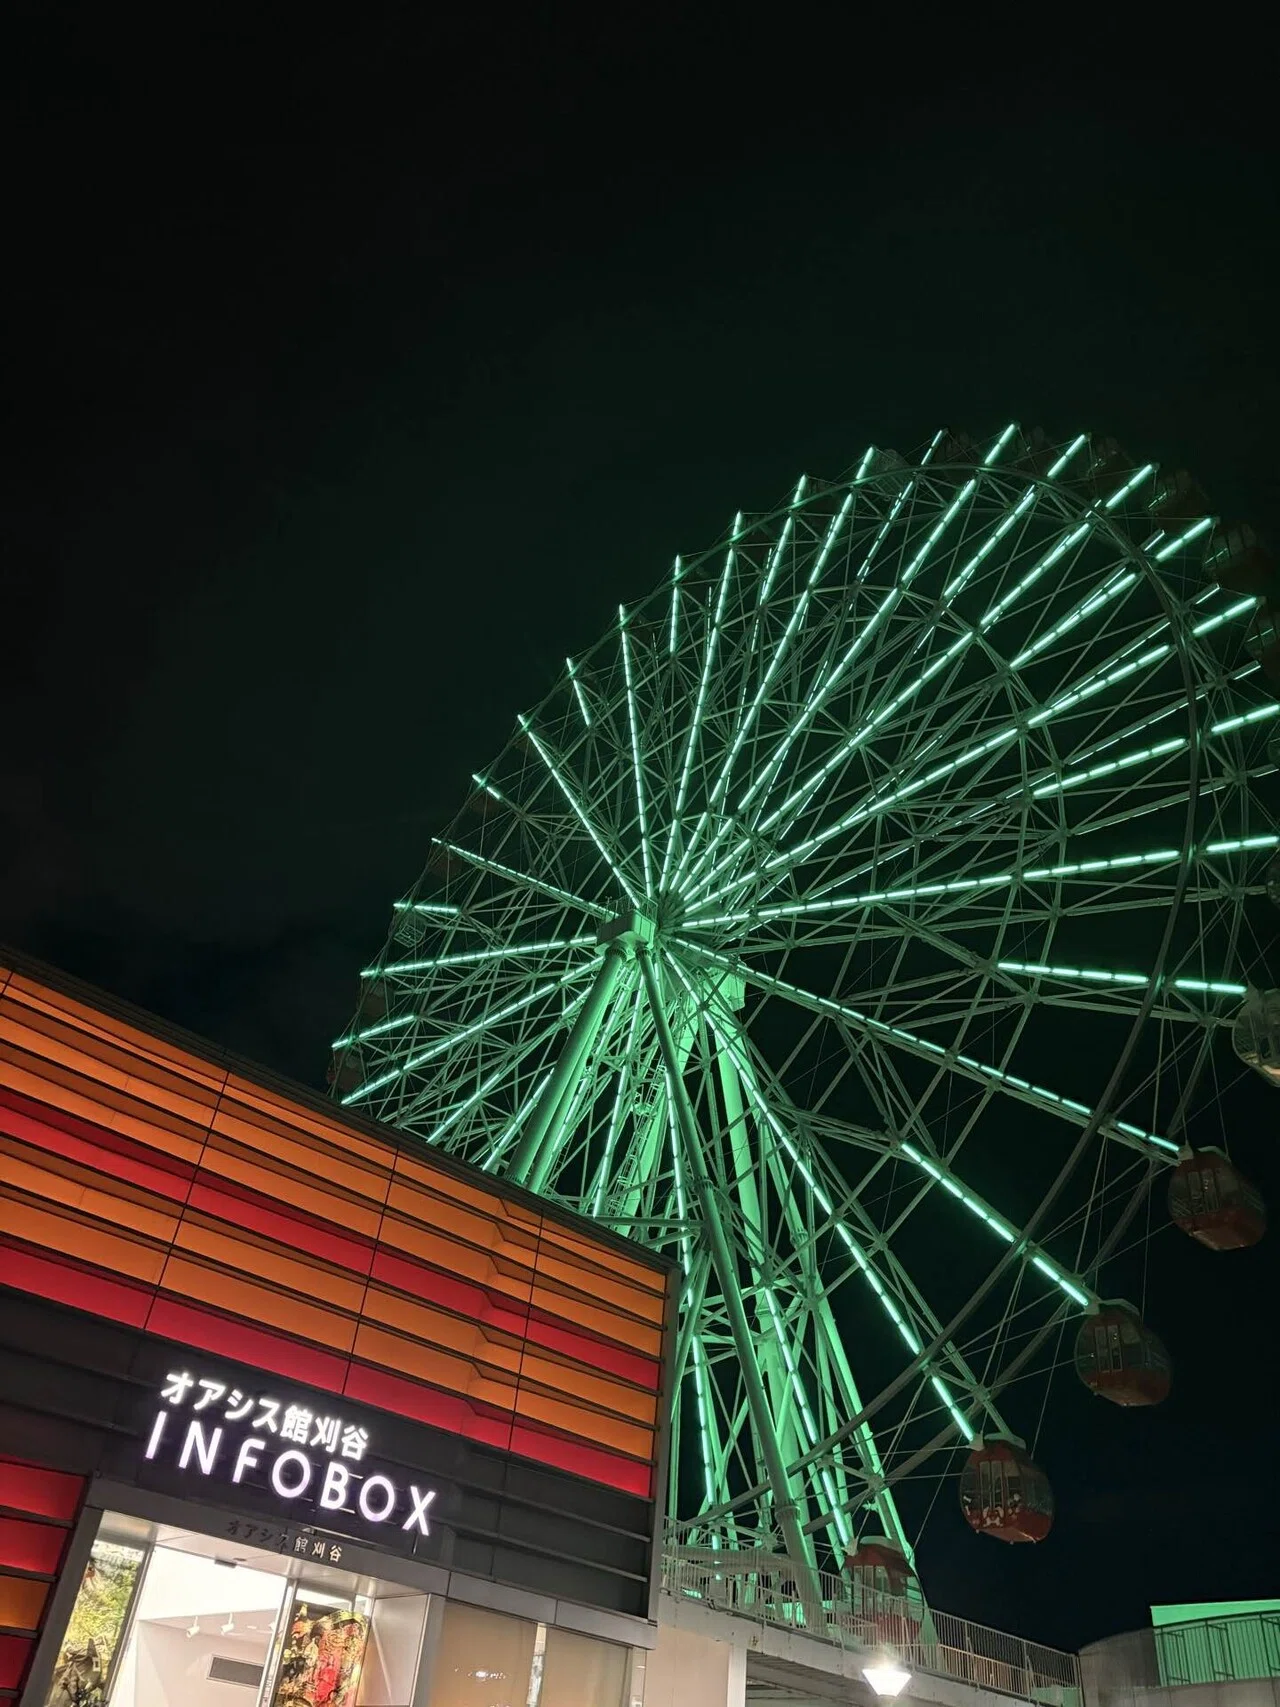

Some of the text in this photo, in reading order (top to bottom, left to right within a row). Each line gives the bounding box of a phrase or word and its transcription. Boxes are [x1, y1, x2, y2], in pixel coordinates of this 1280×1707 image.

[161, 1371, 370, 1460] オアシス館刈谷
[145, 1411, 436, 1535] INFOBOX
[227, 1520, 342, 1562] オアシス館刈谷
